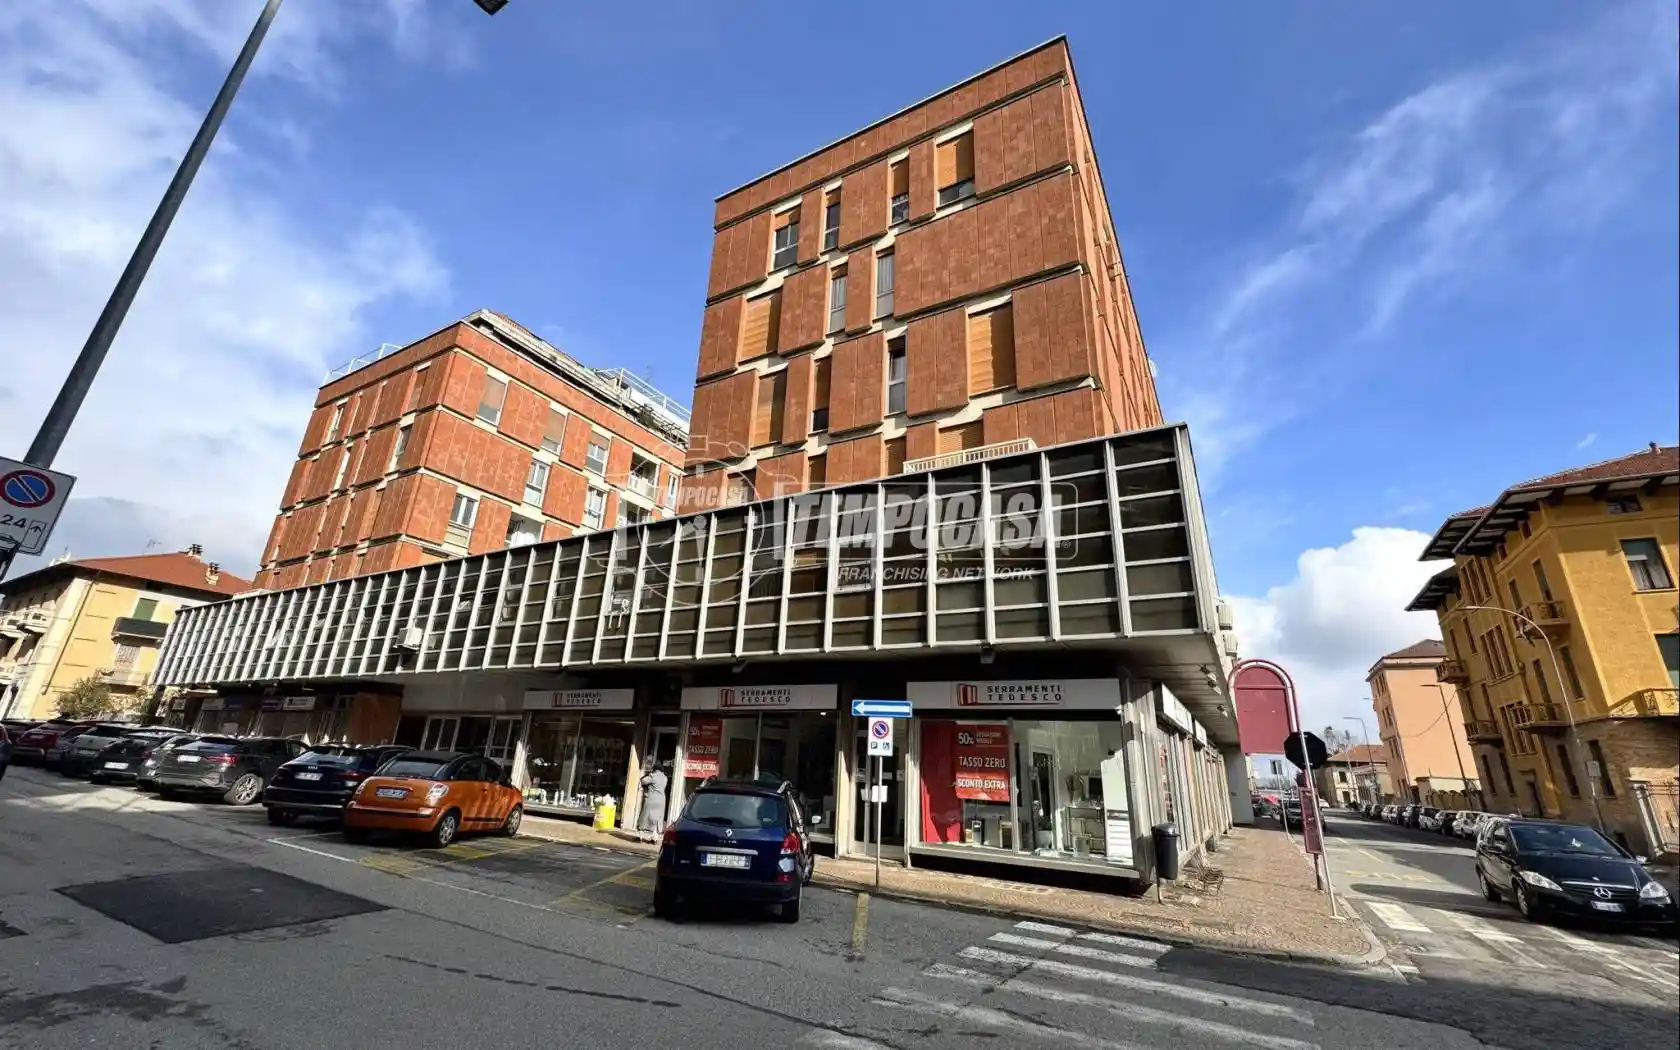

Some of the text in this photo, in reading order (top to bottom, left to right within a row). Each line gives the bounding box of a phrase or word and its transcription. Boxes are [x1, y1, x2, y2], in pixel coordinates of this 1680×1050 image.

[987, 685, 1061, 693] SERRAMENTI
[988, 693, 1062, 701] TEDESCO
[958, 732, 975, 745] 50%
[960, 756, 1006, 769] TASSO ZERO
[957, 778, 1006, 790] SCONTO EXTRA
